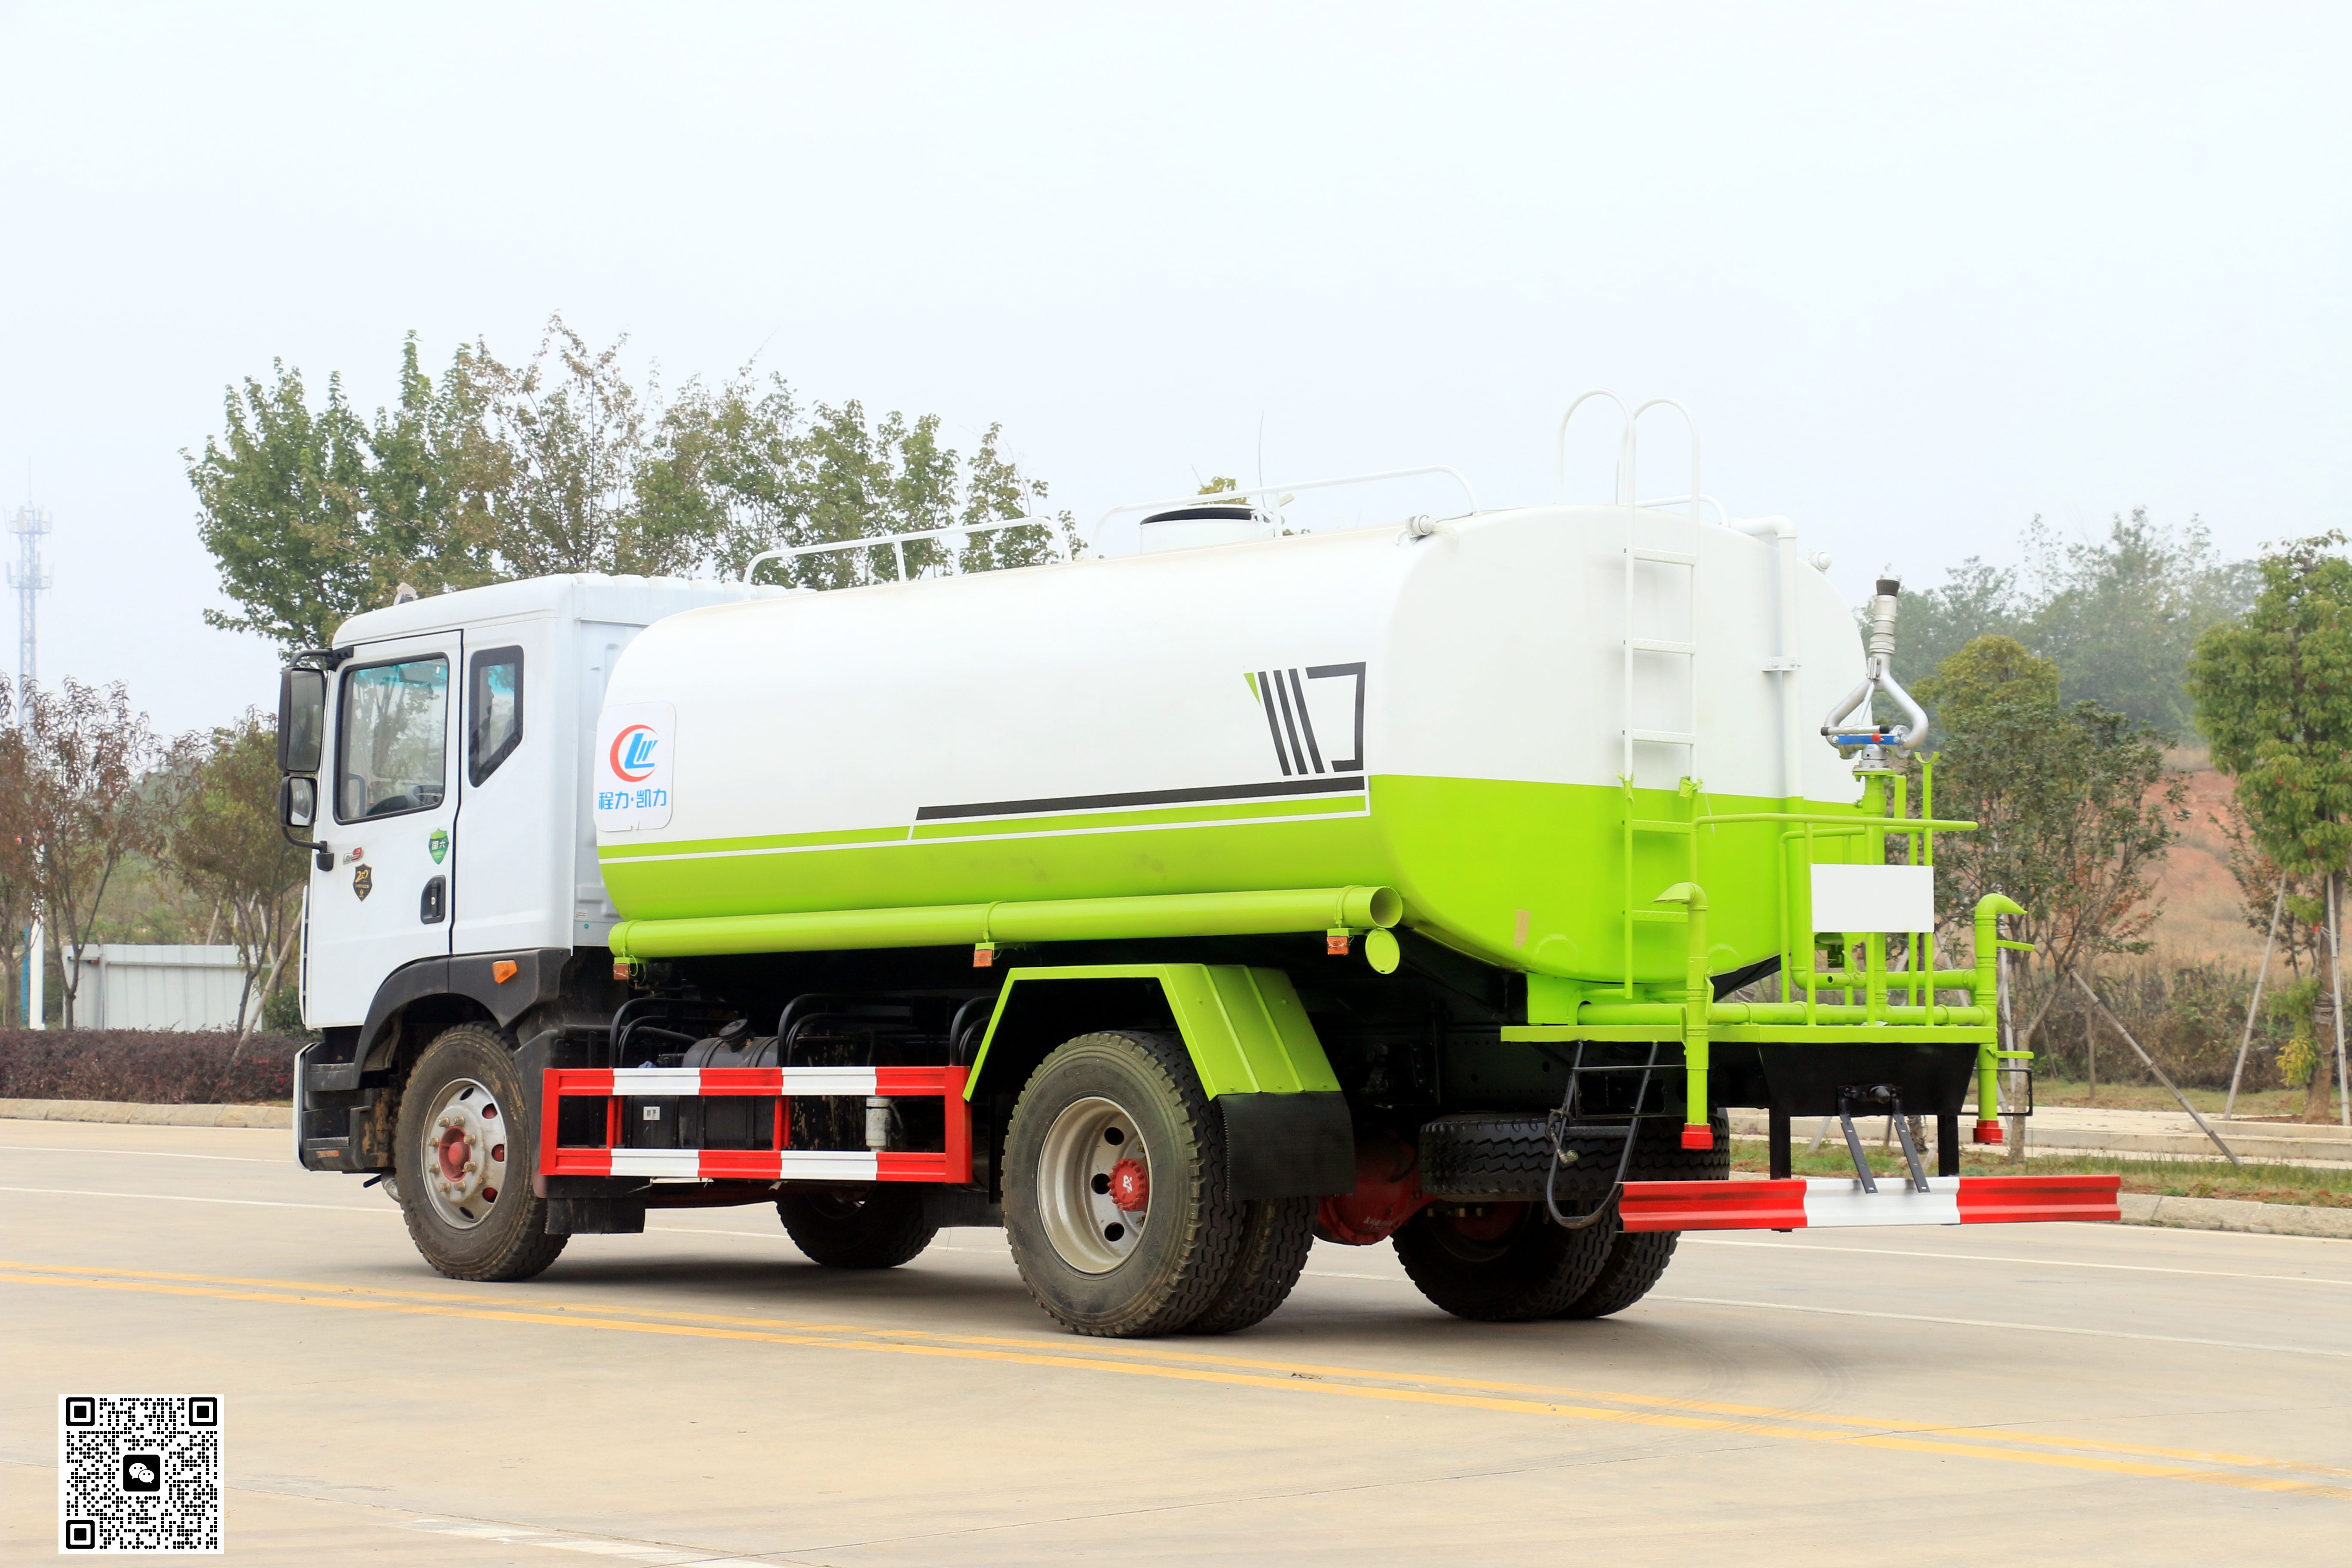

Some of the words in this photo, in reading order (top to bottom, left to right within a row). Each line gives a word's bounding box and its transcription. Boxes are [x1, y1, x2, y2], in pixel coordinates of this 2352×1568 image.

[598, 789, 667, 810] 程力·凯力
[432, 840, 446, 850] 国六
